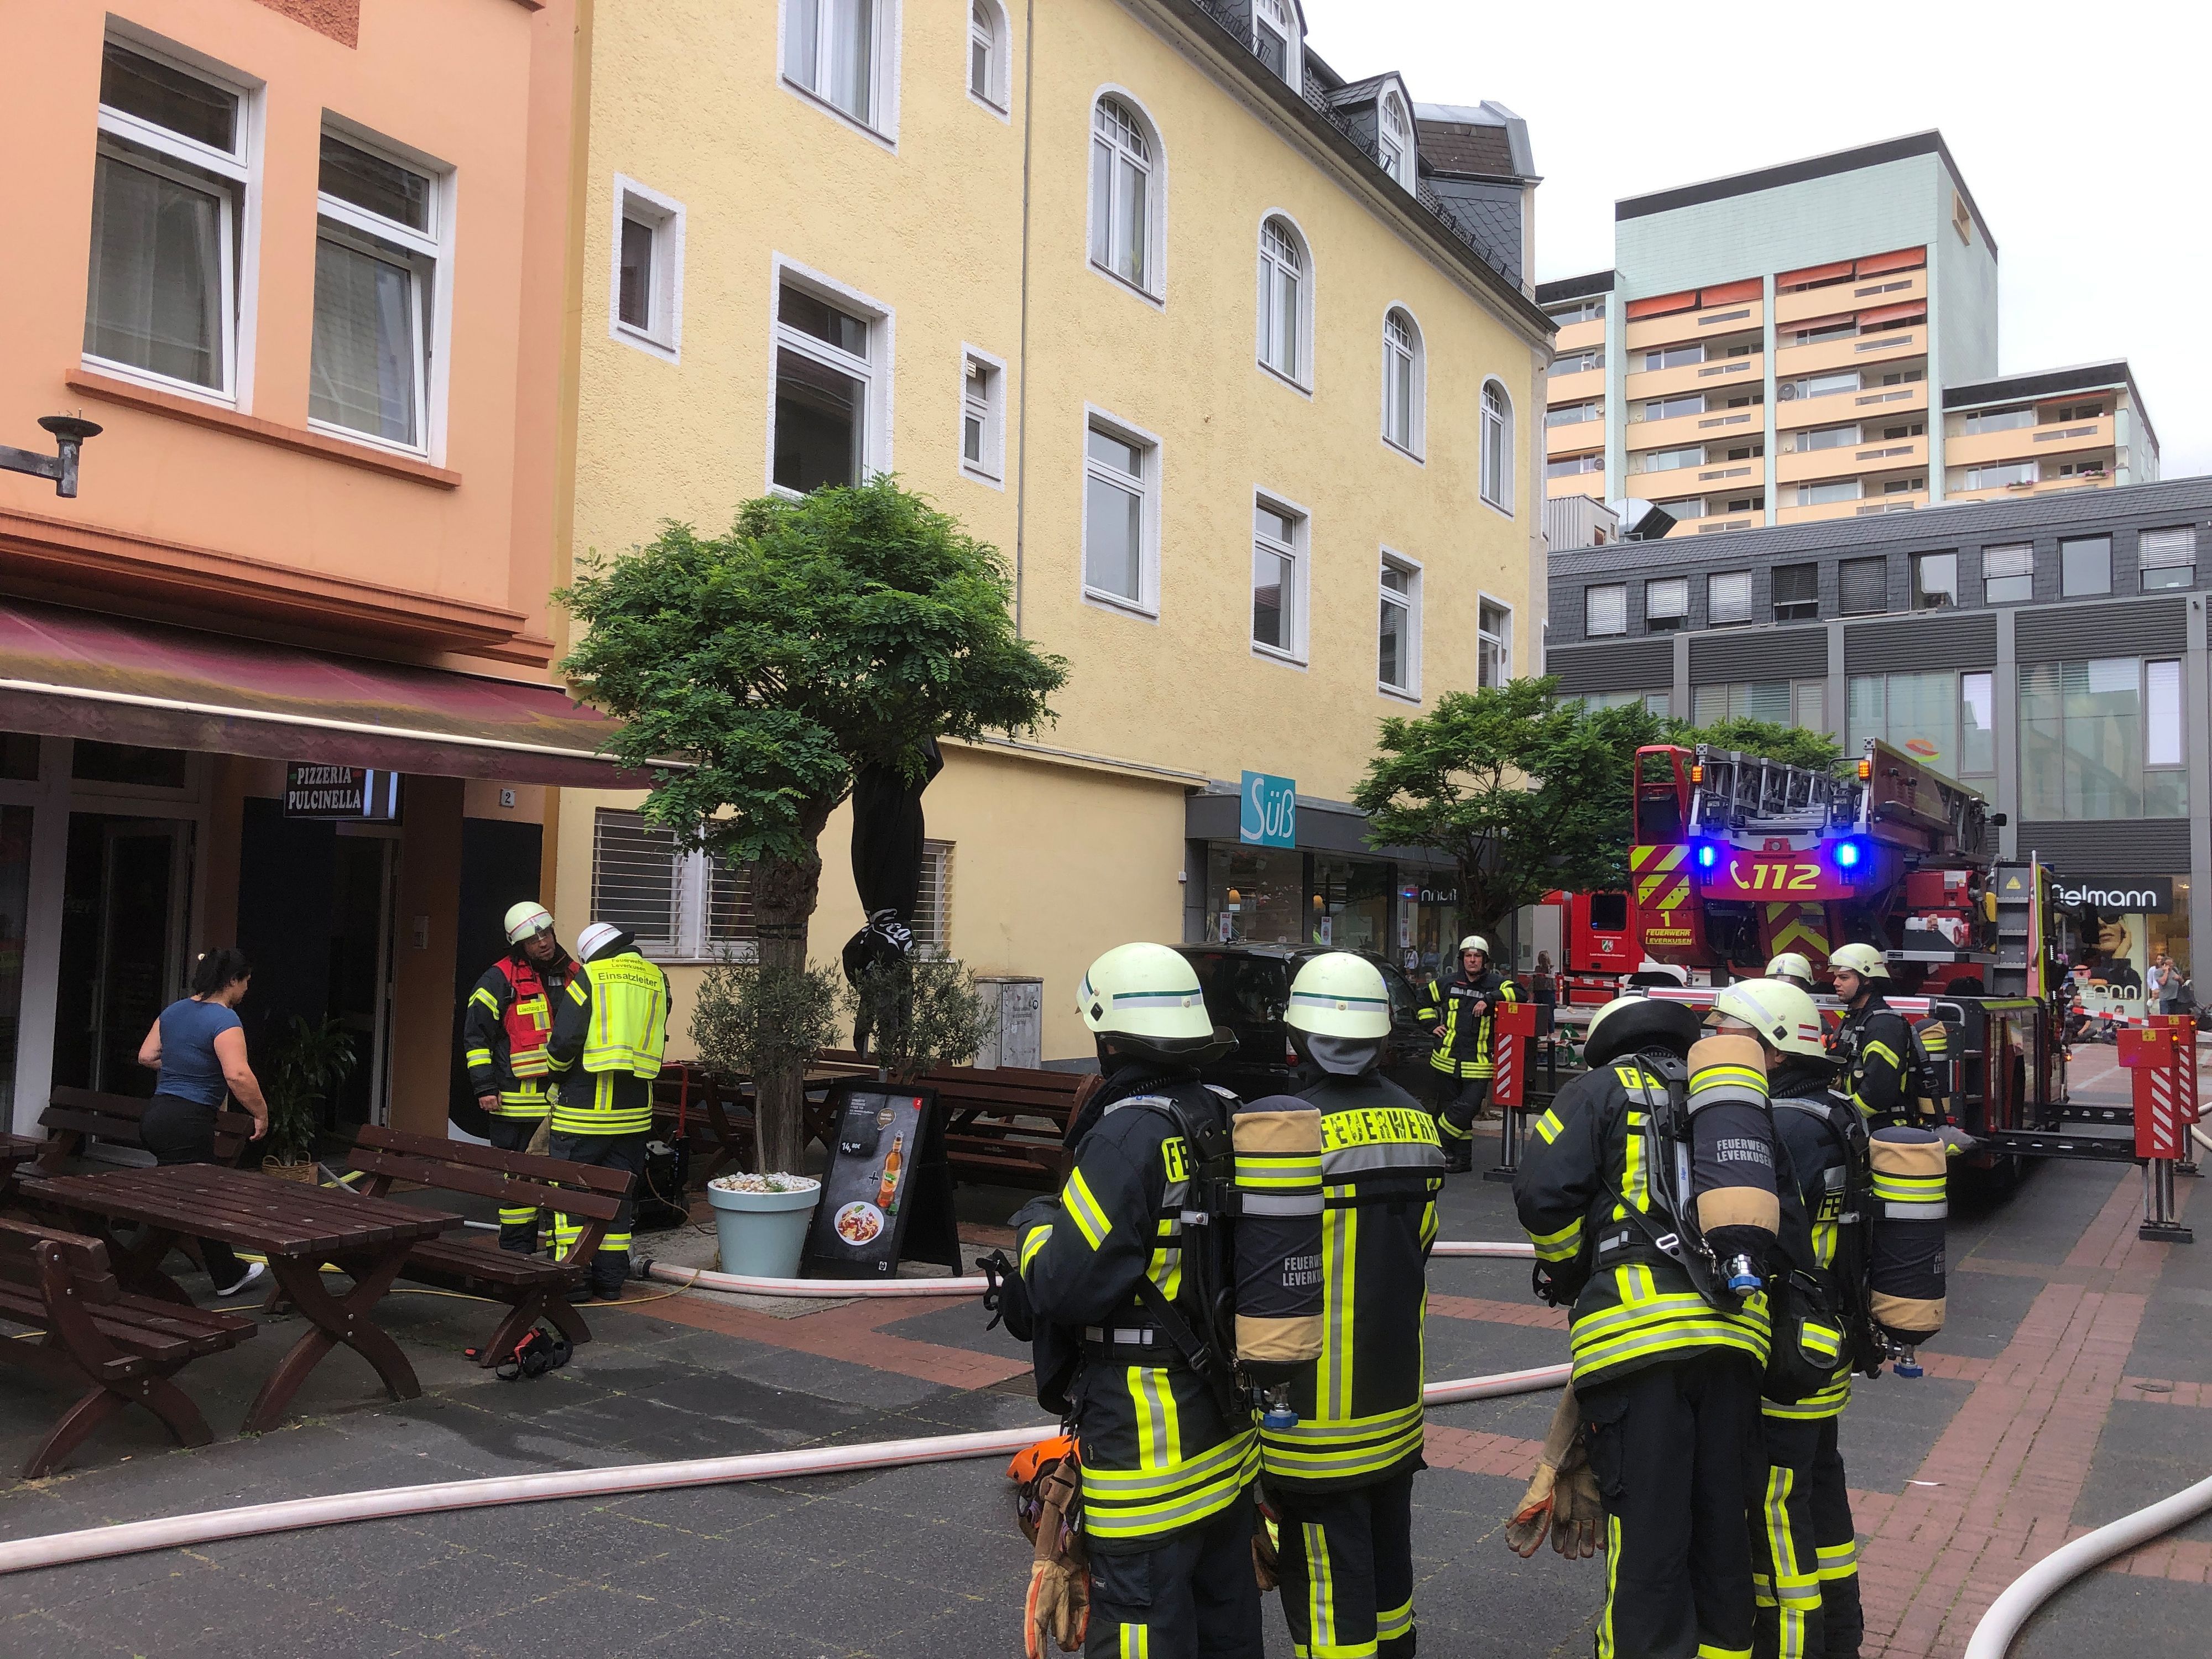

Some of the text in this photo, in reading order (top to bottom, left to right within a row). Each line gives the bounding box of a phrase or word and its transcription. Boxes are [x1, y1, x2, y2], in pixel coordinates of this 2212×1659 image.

[297, 766, 352, 785] PIZZERIA
[288, 789, 361, 810] PULCINELLA
[505, 792, 511, 804] 2
[1240, 778, 1294, 840] Süß
[1753, 864, 1821, 890] 112
[1661, 911, 1670, 927] 1
[1645, 936, 1692, 945] LEVERKUSEN
[612, 963, 646, 972] Leverkusen
[598, 972, 658, 987] Einsatzleiter
[1321, 1110, 1439, 1149] FEUERWEHR
